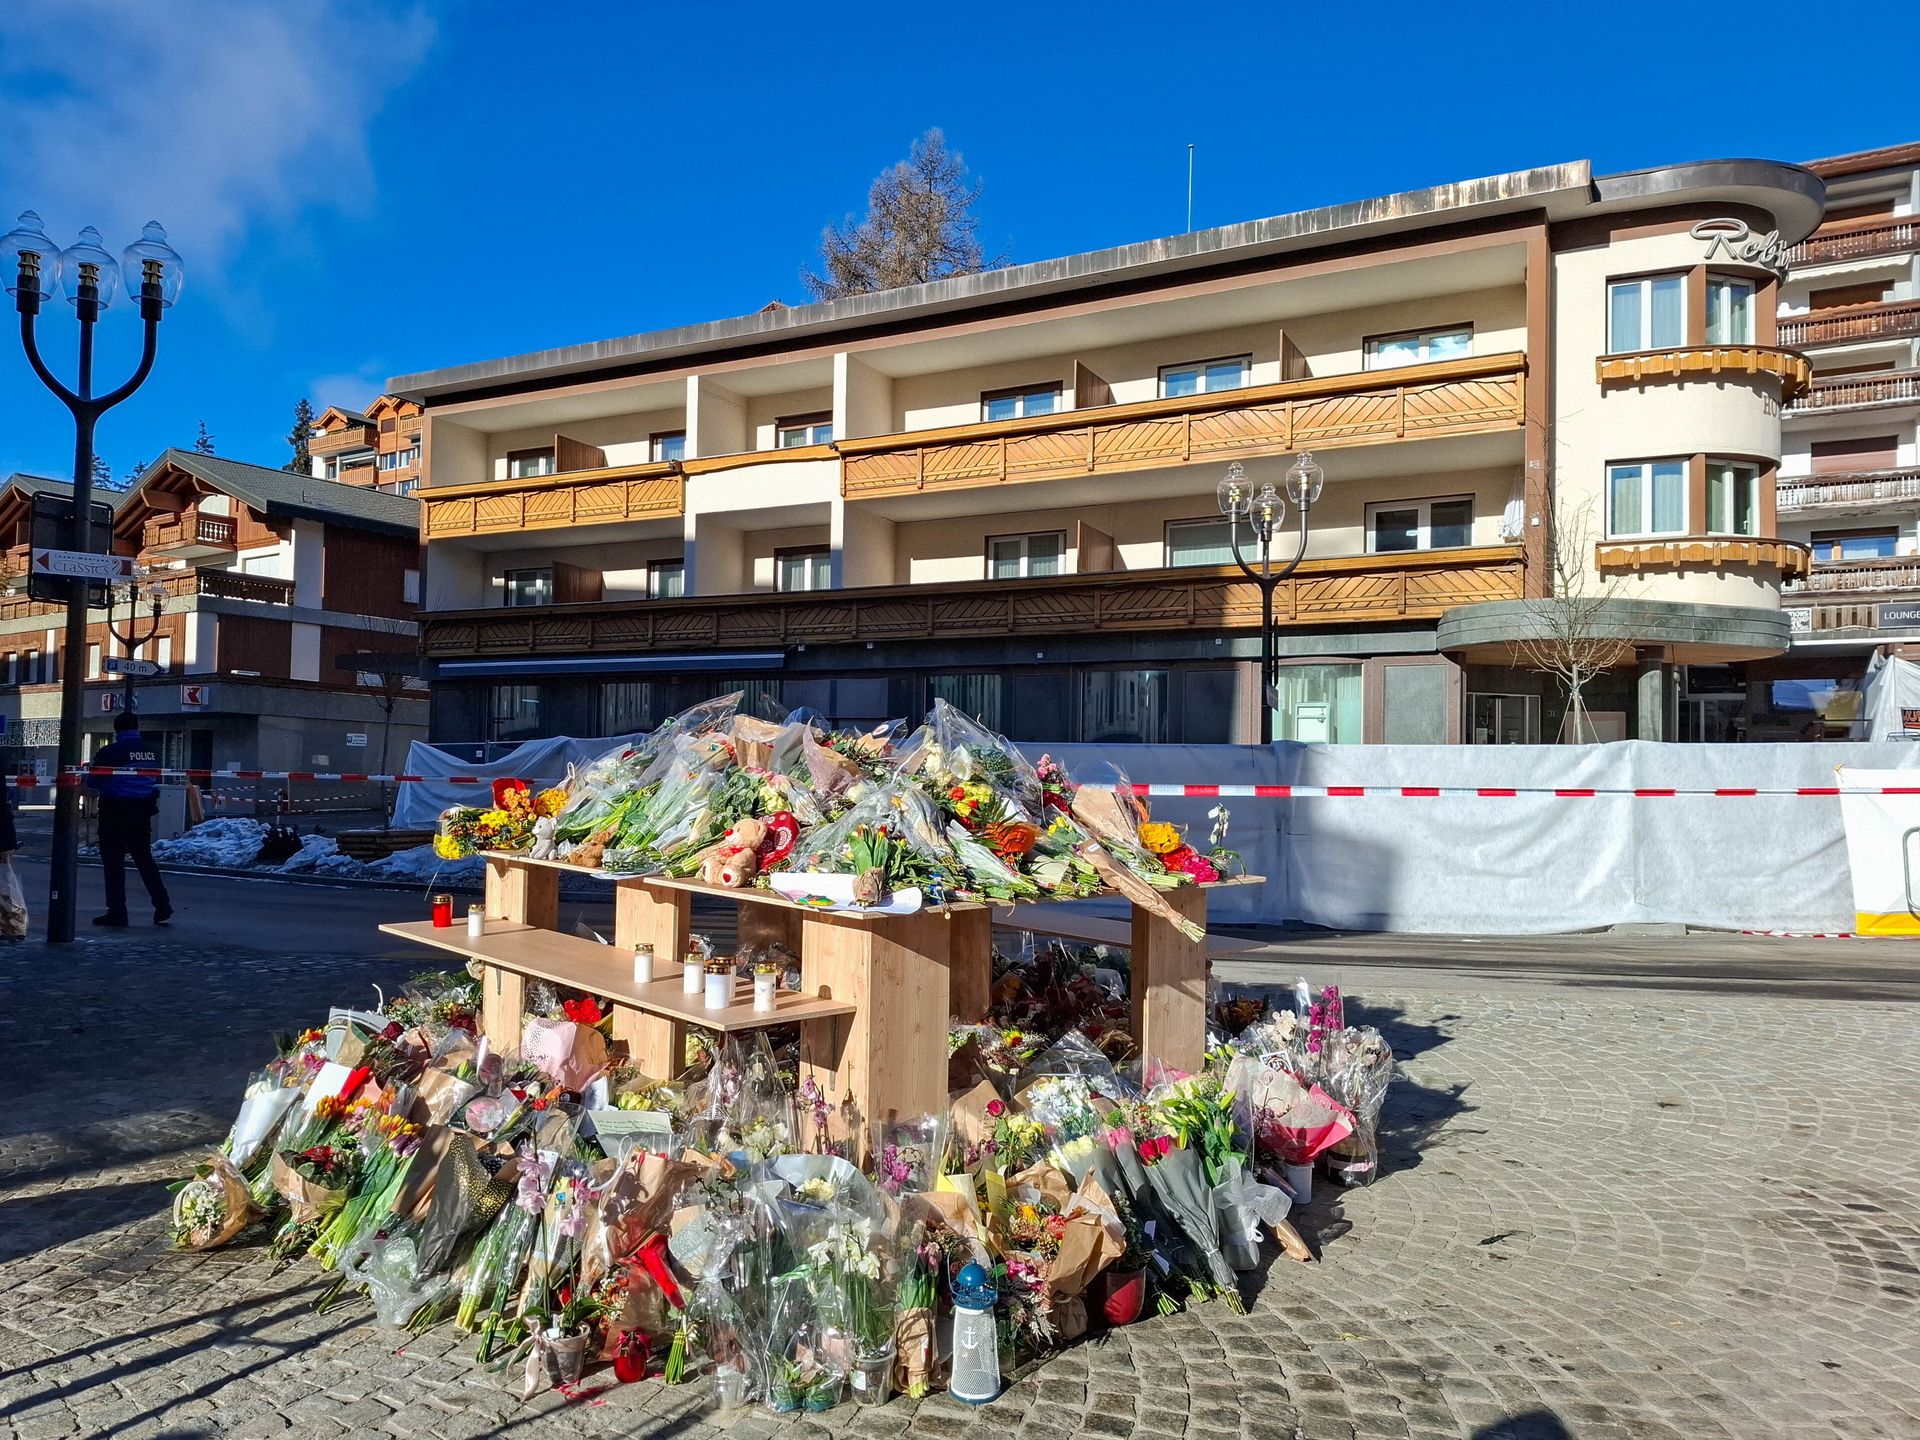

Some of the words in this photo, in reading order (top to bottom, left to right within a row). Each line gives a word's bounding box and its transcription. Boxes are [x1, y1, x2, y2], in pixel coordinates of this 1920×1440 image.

[123, 662, 136, 672] 40
[138, 665, 147, 673] m
[129, 751, 156, 761] POLICE
